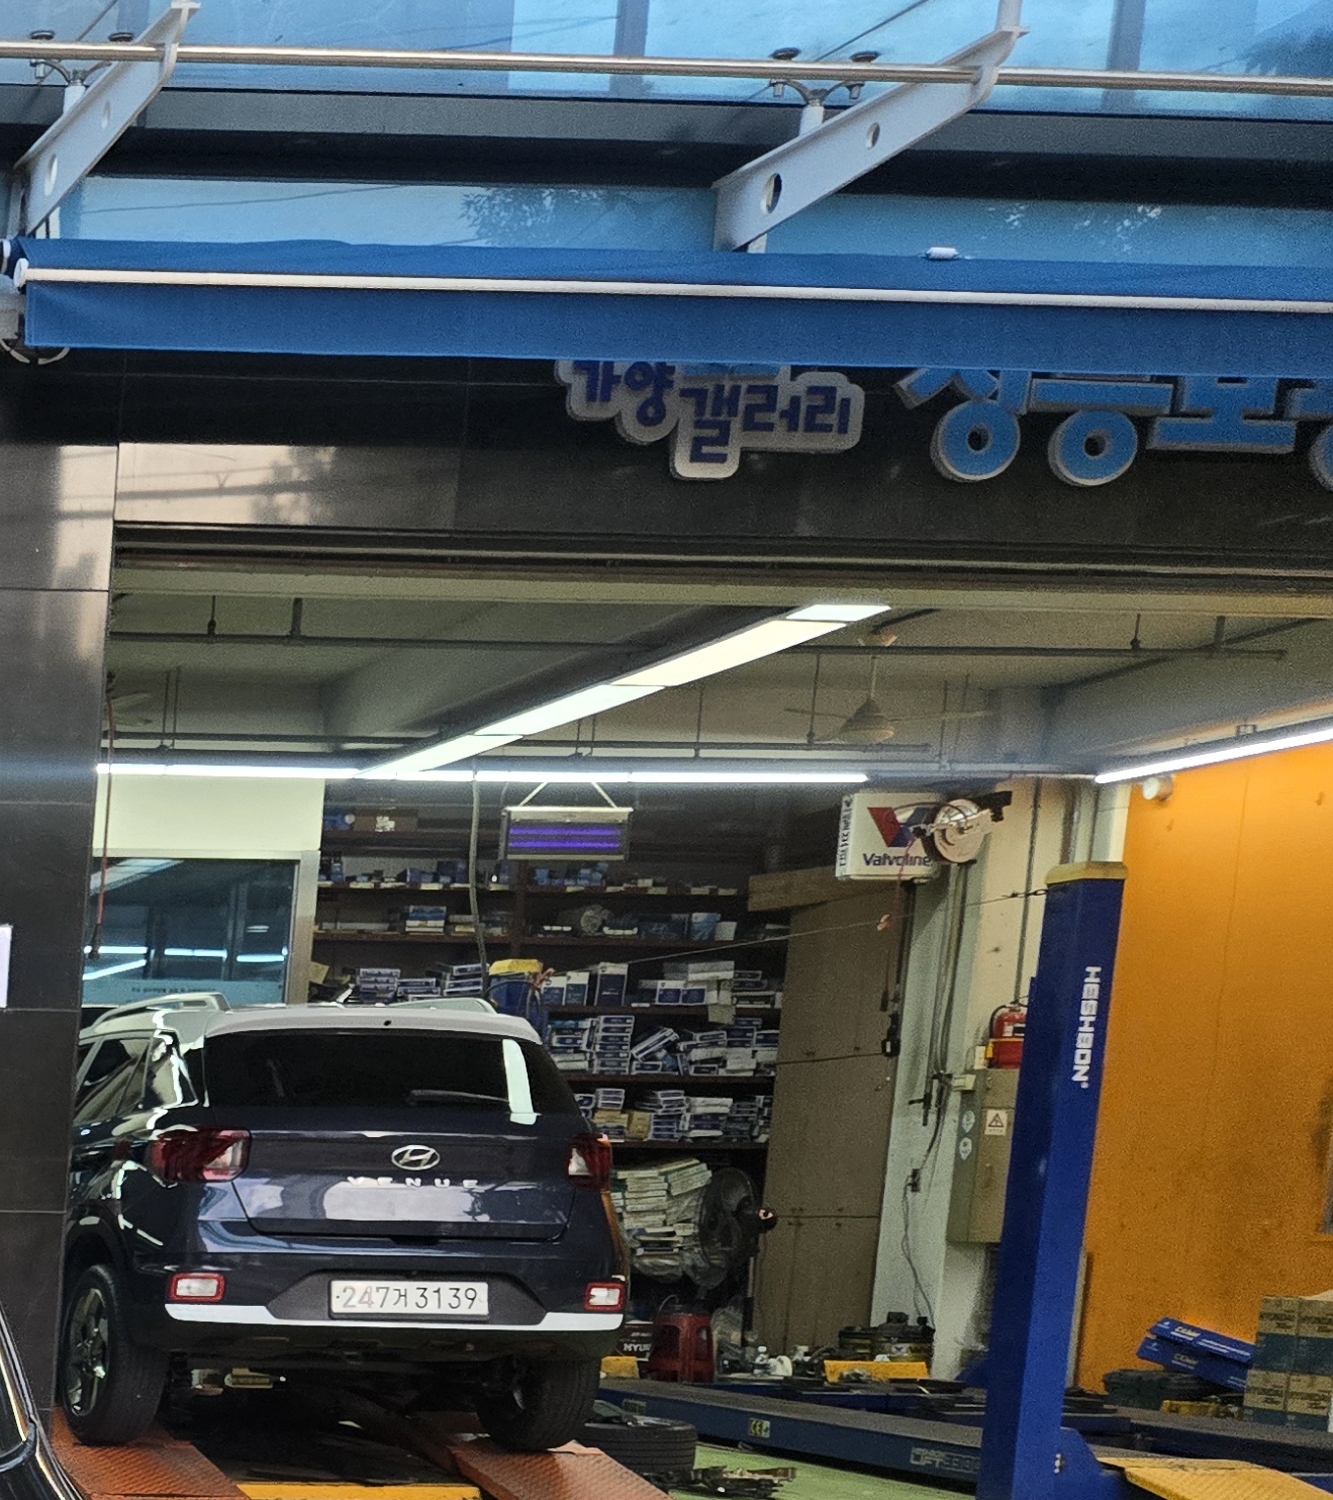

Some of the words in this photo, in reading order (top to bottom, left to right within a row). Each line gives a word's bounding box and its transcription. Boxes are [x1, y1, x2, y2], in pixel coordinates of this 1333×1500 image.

[679, 384, 851, 464] 갤러리
[863, 853, 931, 867] Valvoline
[347, 1176, 478, 1188] VENUE
